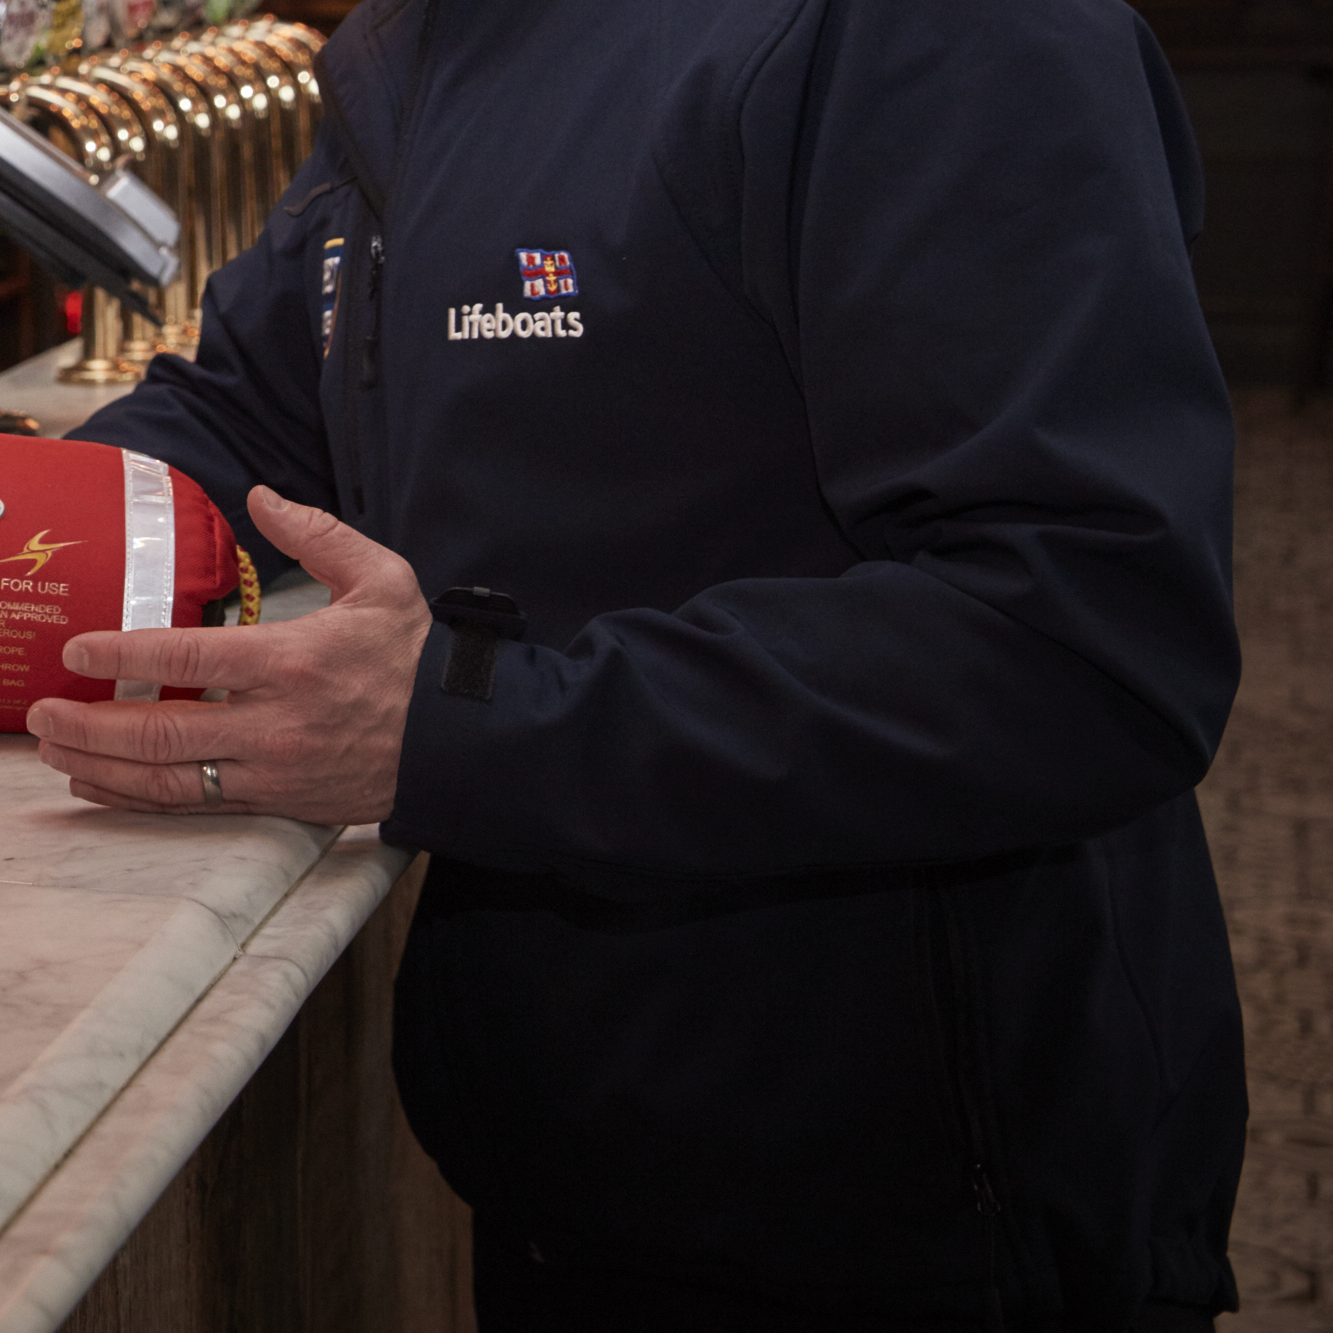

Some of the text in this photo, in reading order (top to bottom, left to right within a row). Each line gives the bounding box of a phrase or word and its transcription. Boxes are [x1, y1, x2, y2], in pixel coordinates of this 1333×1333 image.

[448, 303, 583, 340] Lifeboats
[1, 578, 34, 592] FOR
[38, 582, 70, 596] USE
[11, 612, 69, 625] APPROVED
